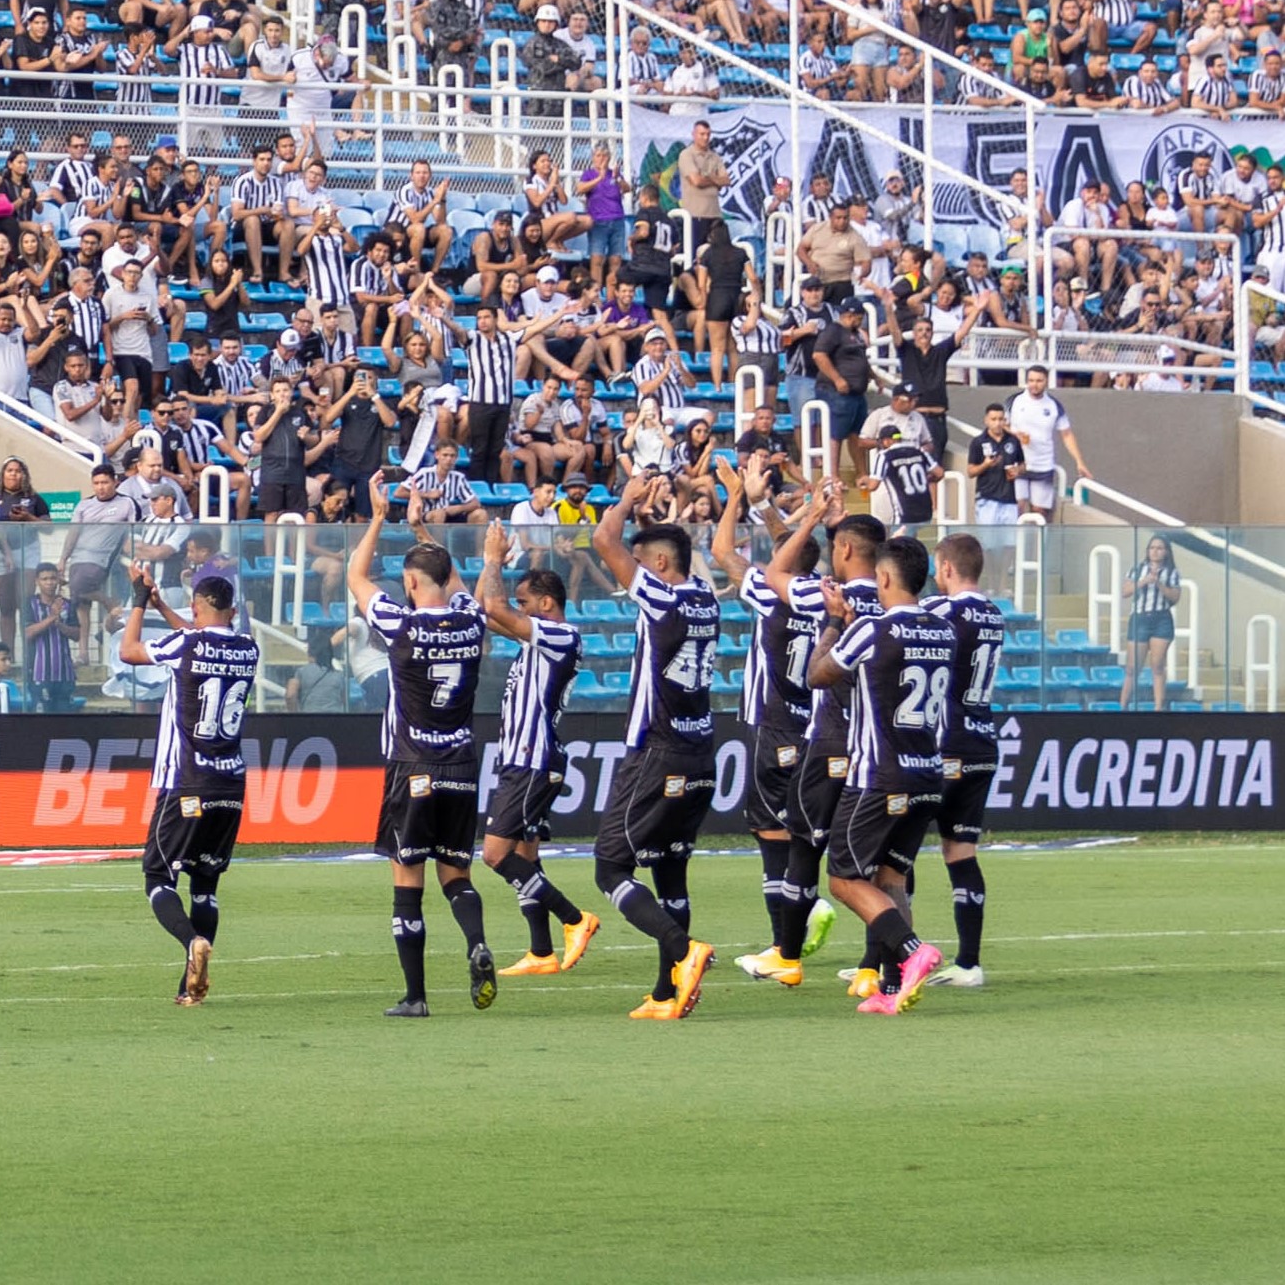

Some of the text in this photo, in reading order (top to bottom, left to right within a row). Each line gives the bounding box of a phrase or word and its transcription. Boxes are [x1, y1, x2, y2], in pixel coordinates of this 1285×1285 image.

[1164, 128, 1219, 156] ALFA
[898, 463, 927, 495] 10
[417, 624, 481, 644] brisanet
[204, 644, 259, 662] brisanet
[412, 644, 480, 660] F. CASTRO
[190, 661, 227, 675] ERICK
[427, 662, 463, 708] 7
[893, 666, 950, 729] 28
[193, 676, 249, 740] 16
[1021, 738, 1273, 809] ACREDITA
